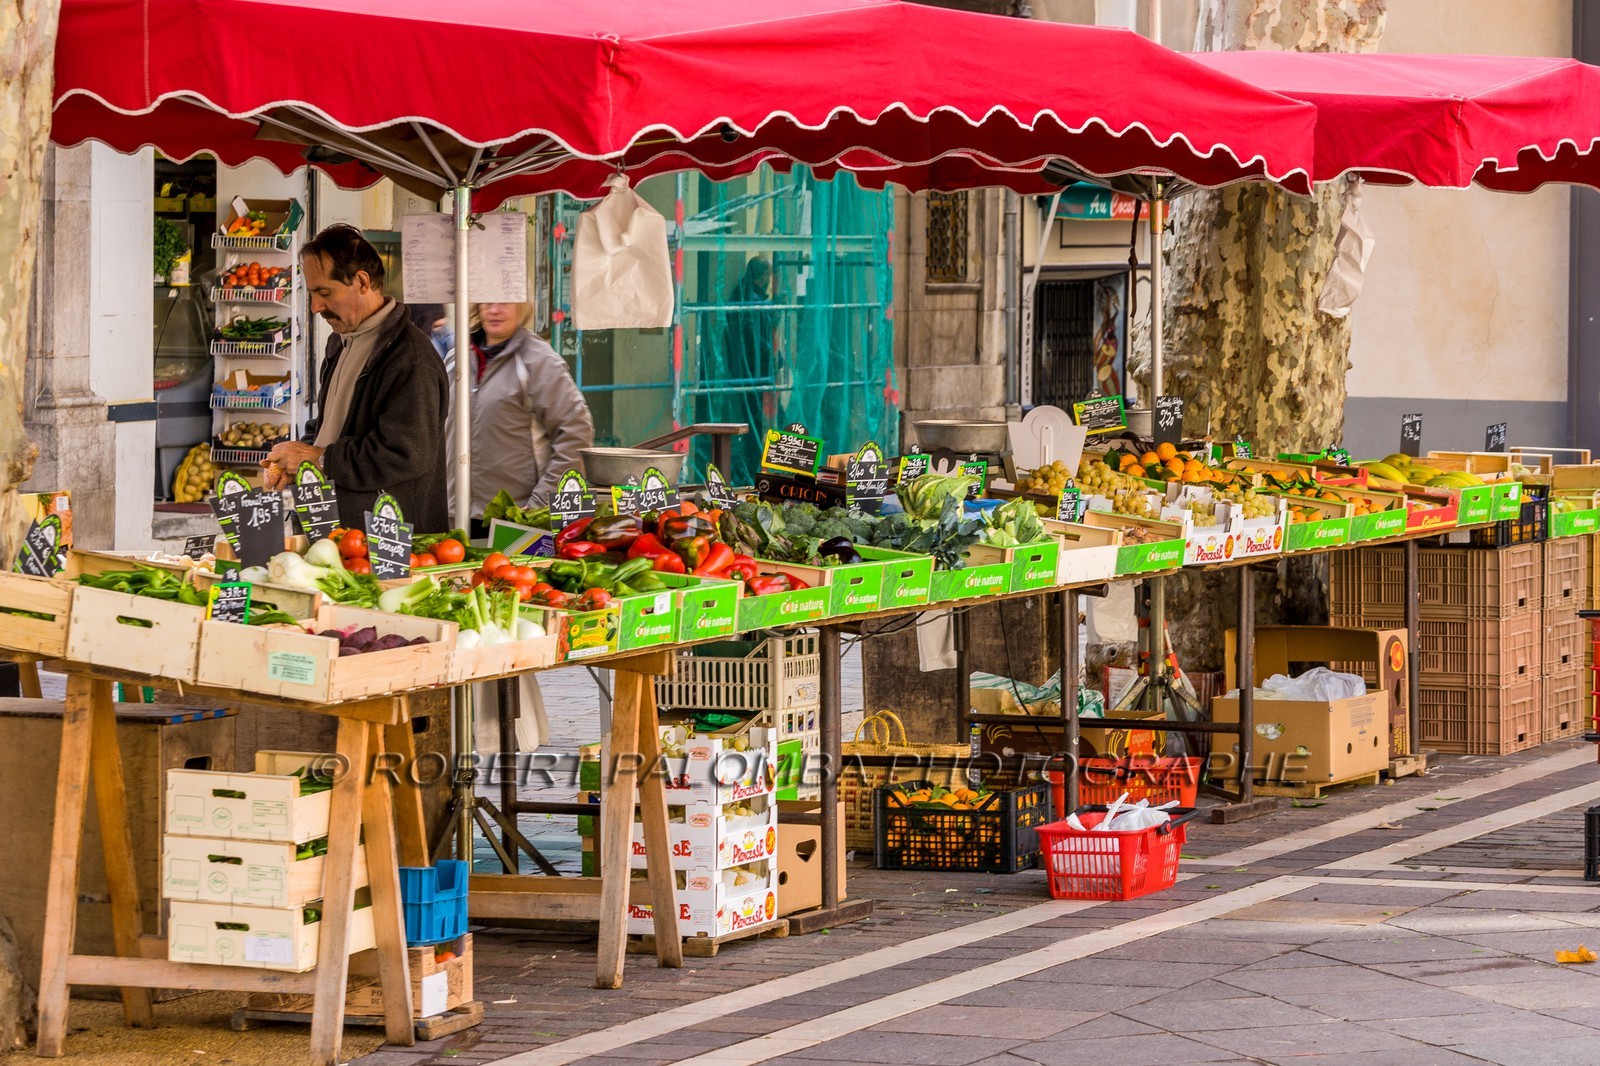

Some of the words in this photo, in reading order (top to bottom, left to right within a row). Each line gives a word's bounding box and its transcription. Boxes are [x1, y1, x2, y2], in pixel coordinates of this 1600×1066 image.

[1089, 193, 1107, 215] Au
[1160, 550, 1179, 560] nature
[1037, 569, 1054, 580] nature
[981, 575, 1003, 586] nature
[909, 587, 927, 596] nature
[859, 594, 877, 604] nature
[799, 599, 824, 611] nature
[712, 617, 732, 627] nature
[650, 623, 671, 634] nature
